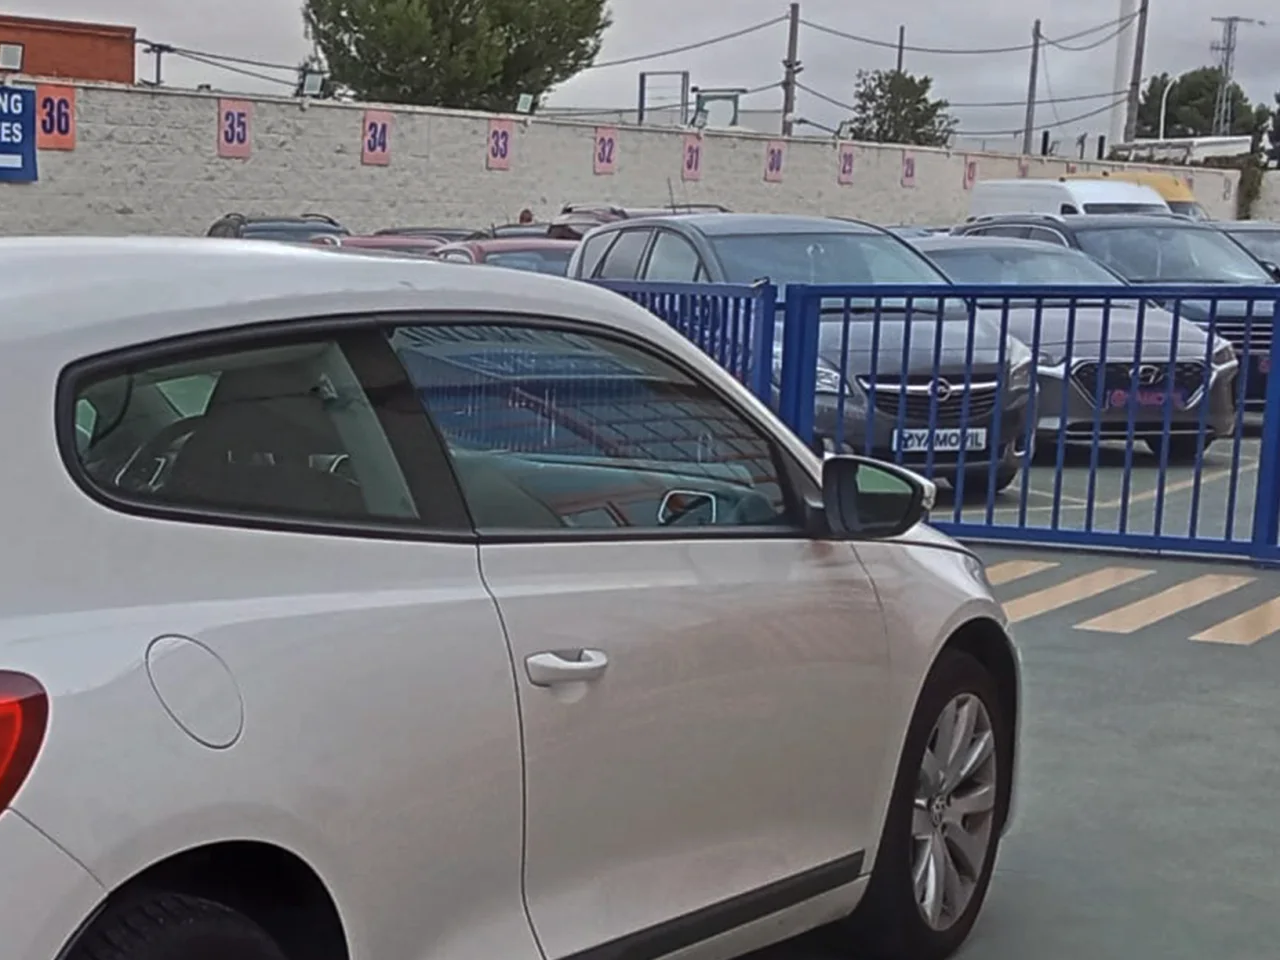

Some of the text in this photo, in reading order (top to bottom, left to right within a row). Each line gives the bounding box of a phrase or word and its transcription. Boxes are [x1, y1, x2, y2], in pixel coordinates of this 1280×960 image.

[42, 96, 70, 135] 36
[223, 112, 248, 144] 35
[367, 121, 387, 153] 34
[491, 130, 510, 160] 33
[597, 137, 615, 165] 32
[686, 146, 700, 171] 31
[769, 149, 783, 172] 30
[914, 432, 983, 448] YMOIL
